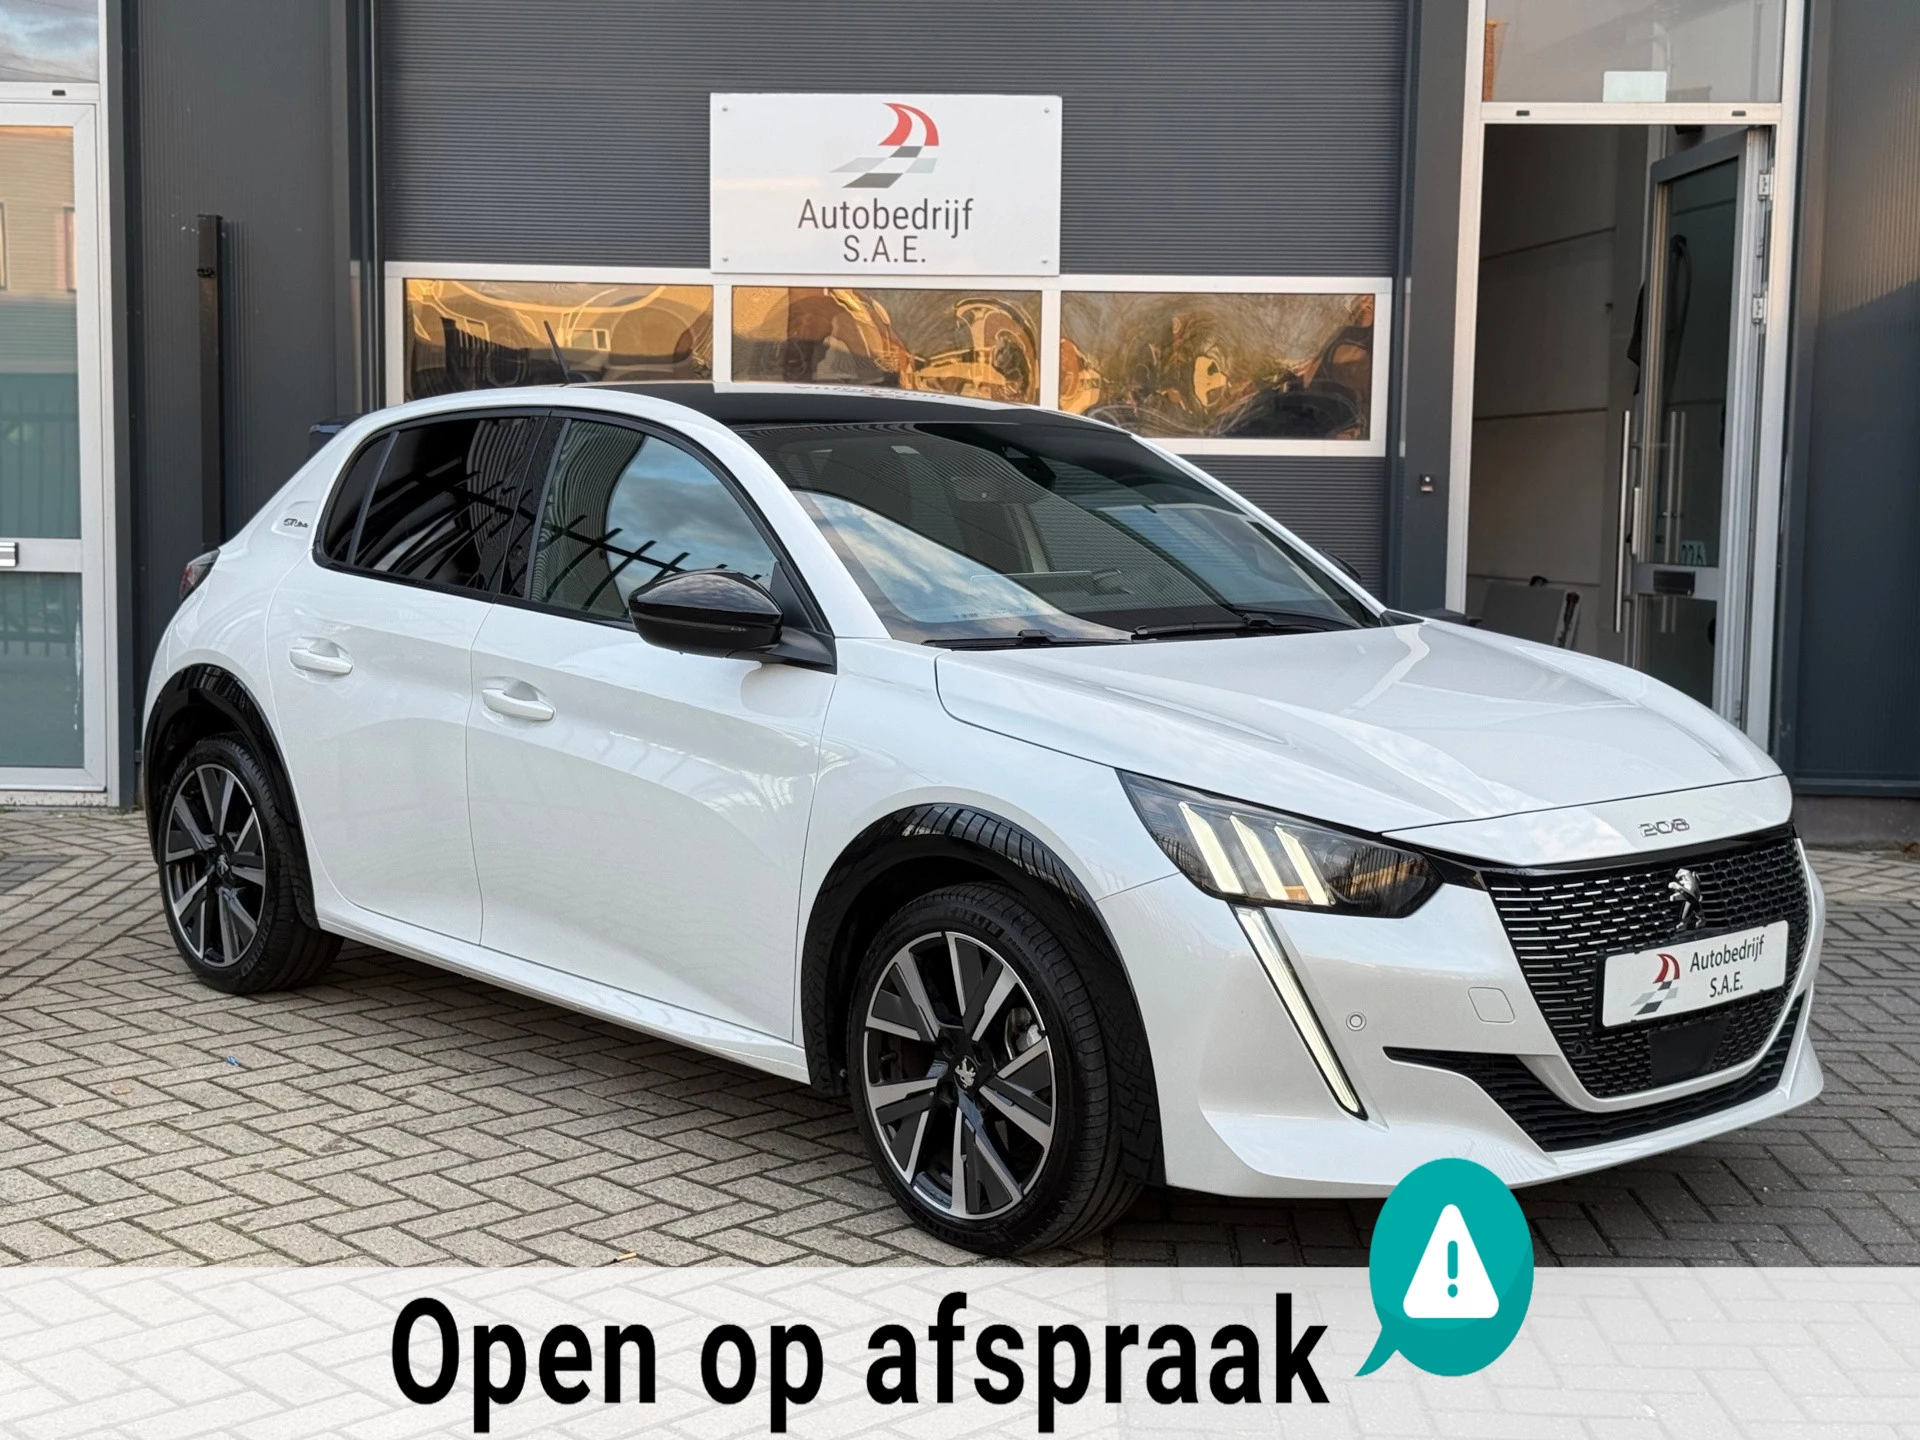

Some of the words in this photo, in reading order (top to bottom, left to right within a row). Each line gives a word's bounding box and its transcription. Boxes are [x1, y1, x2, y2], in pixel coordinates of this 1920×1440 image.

[797, 197, 975, 239] Autobedrijf
[843, 235, 927, 263] S.A.E.
[1638, 818, 1690, 837] 208
[1689, 934, 1766, 973] Autobedrijf
[1709, 971, 1744, 998] S.A.E.
